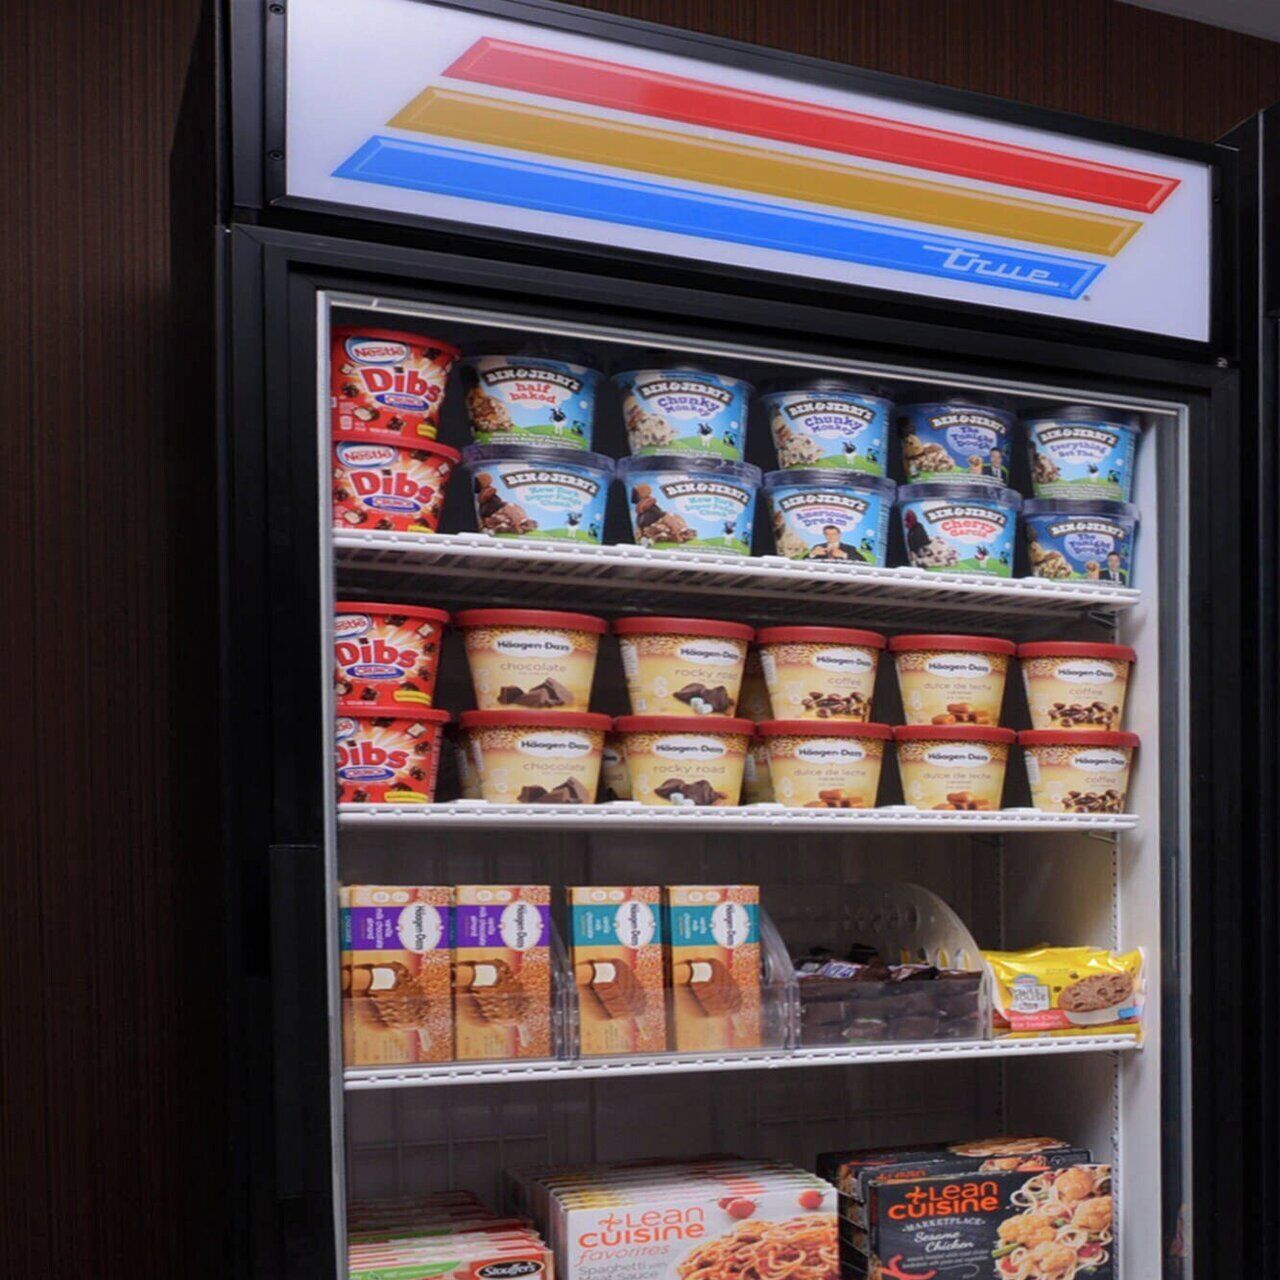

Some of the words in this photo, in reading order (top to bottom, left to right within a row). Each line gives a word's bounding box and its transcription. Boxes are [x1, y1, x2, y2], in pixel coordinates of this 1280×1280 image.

[360, 366, 441, 403] Dibs
[350, 470, 436, 505] Dibs
[335, 639, 419, 667] Dibs
[484, 1262, 536, 1277] Stouffer's
